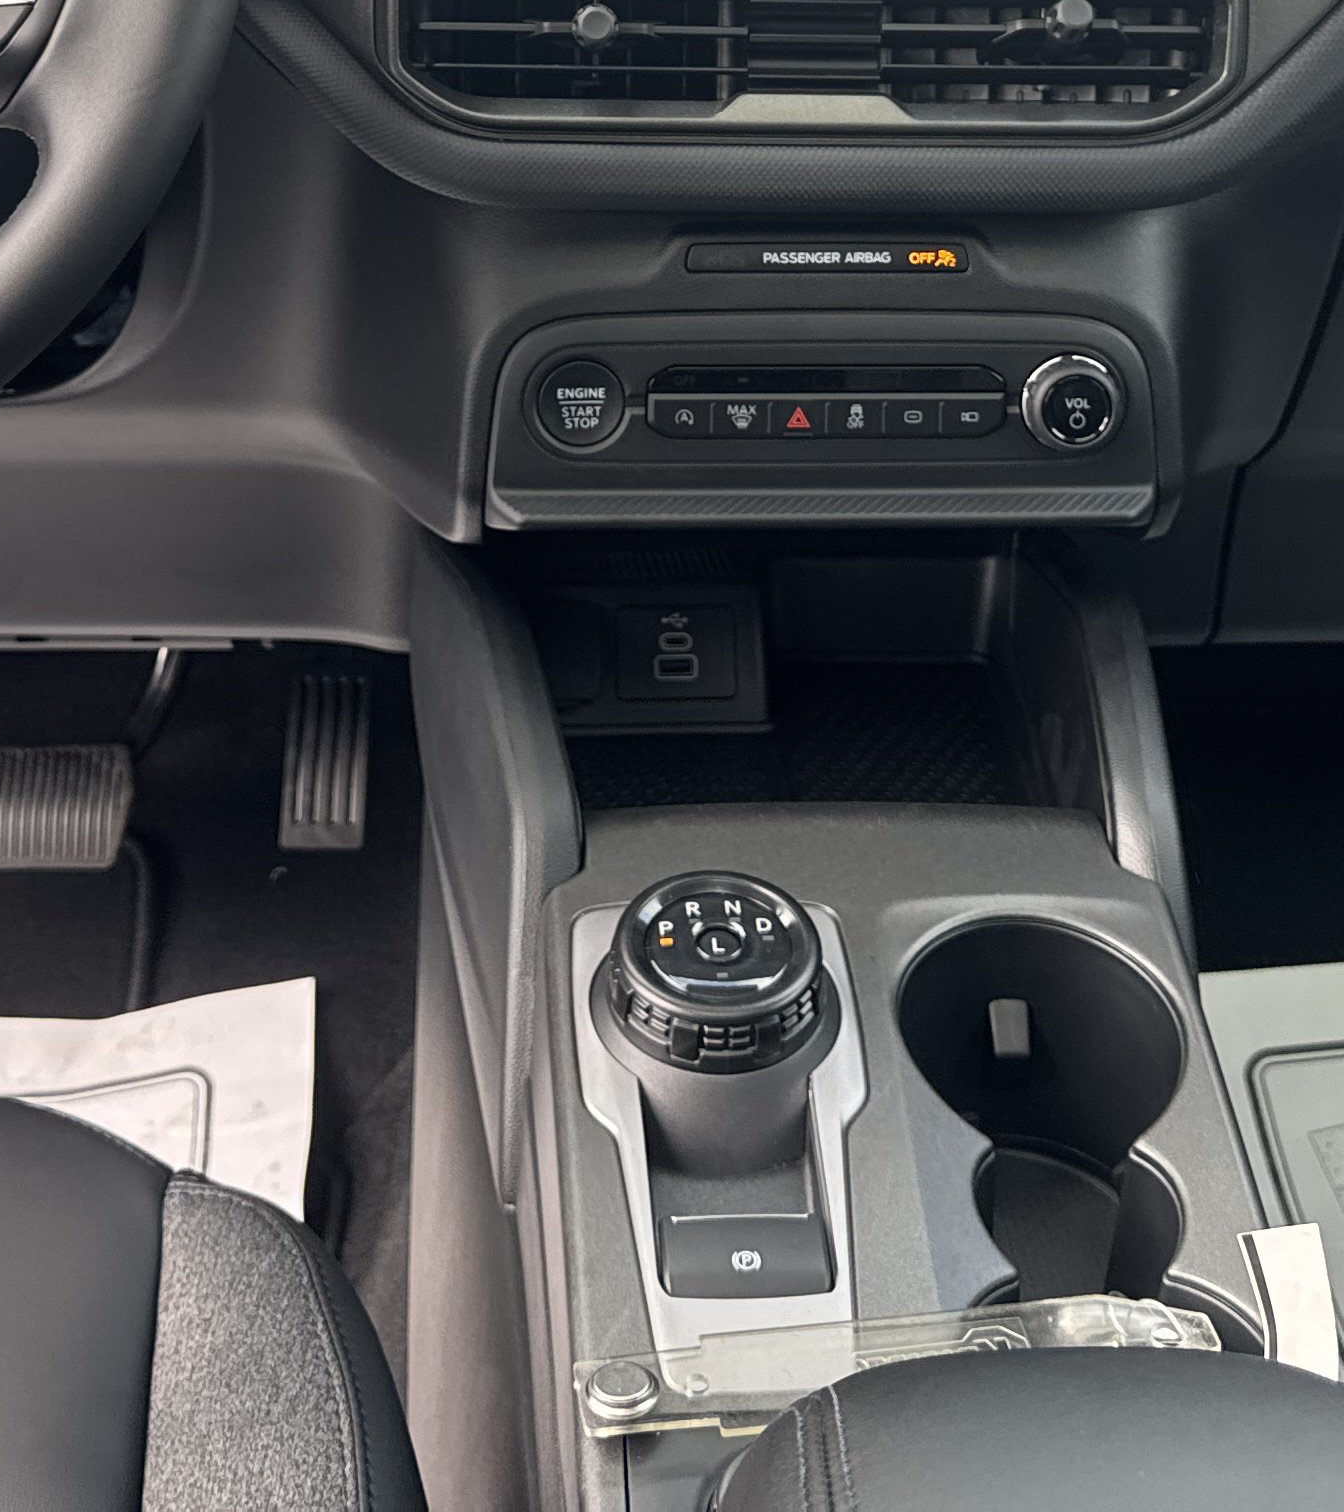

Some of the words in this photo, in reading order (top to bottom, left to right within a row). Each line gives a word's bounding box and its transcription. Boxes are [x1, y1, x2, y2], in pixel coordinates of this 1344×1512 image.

[762, 251, 840, 264] PASSENGER
[844, 251, 891, 263] AIRBAG
[908, 251, 935, 264] OFF
[557, 388, 606, 400] ENGINE
[1065, 398, 1091, 409] VOL
[561, 405, 601, 418] START
[726, 405, 756, 416] MAX
[564, 417, 599, 430] STOP
[685, 901, 701, 917] R
[724, 899, 741, 916] N
[658, 920, 674, 937] P
[755, 917, 772, 934] D
[711, 937, 726, 954] L
